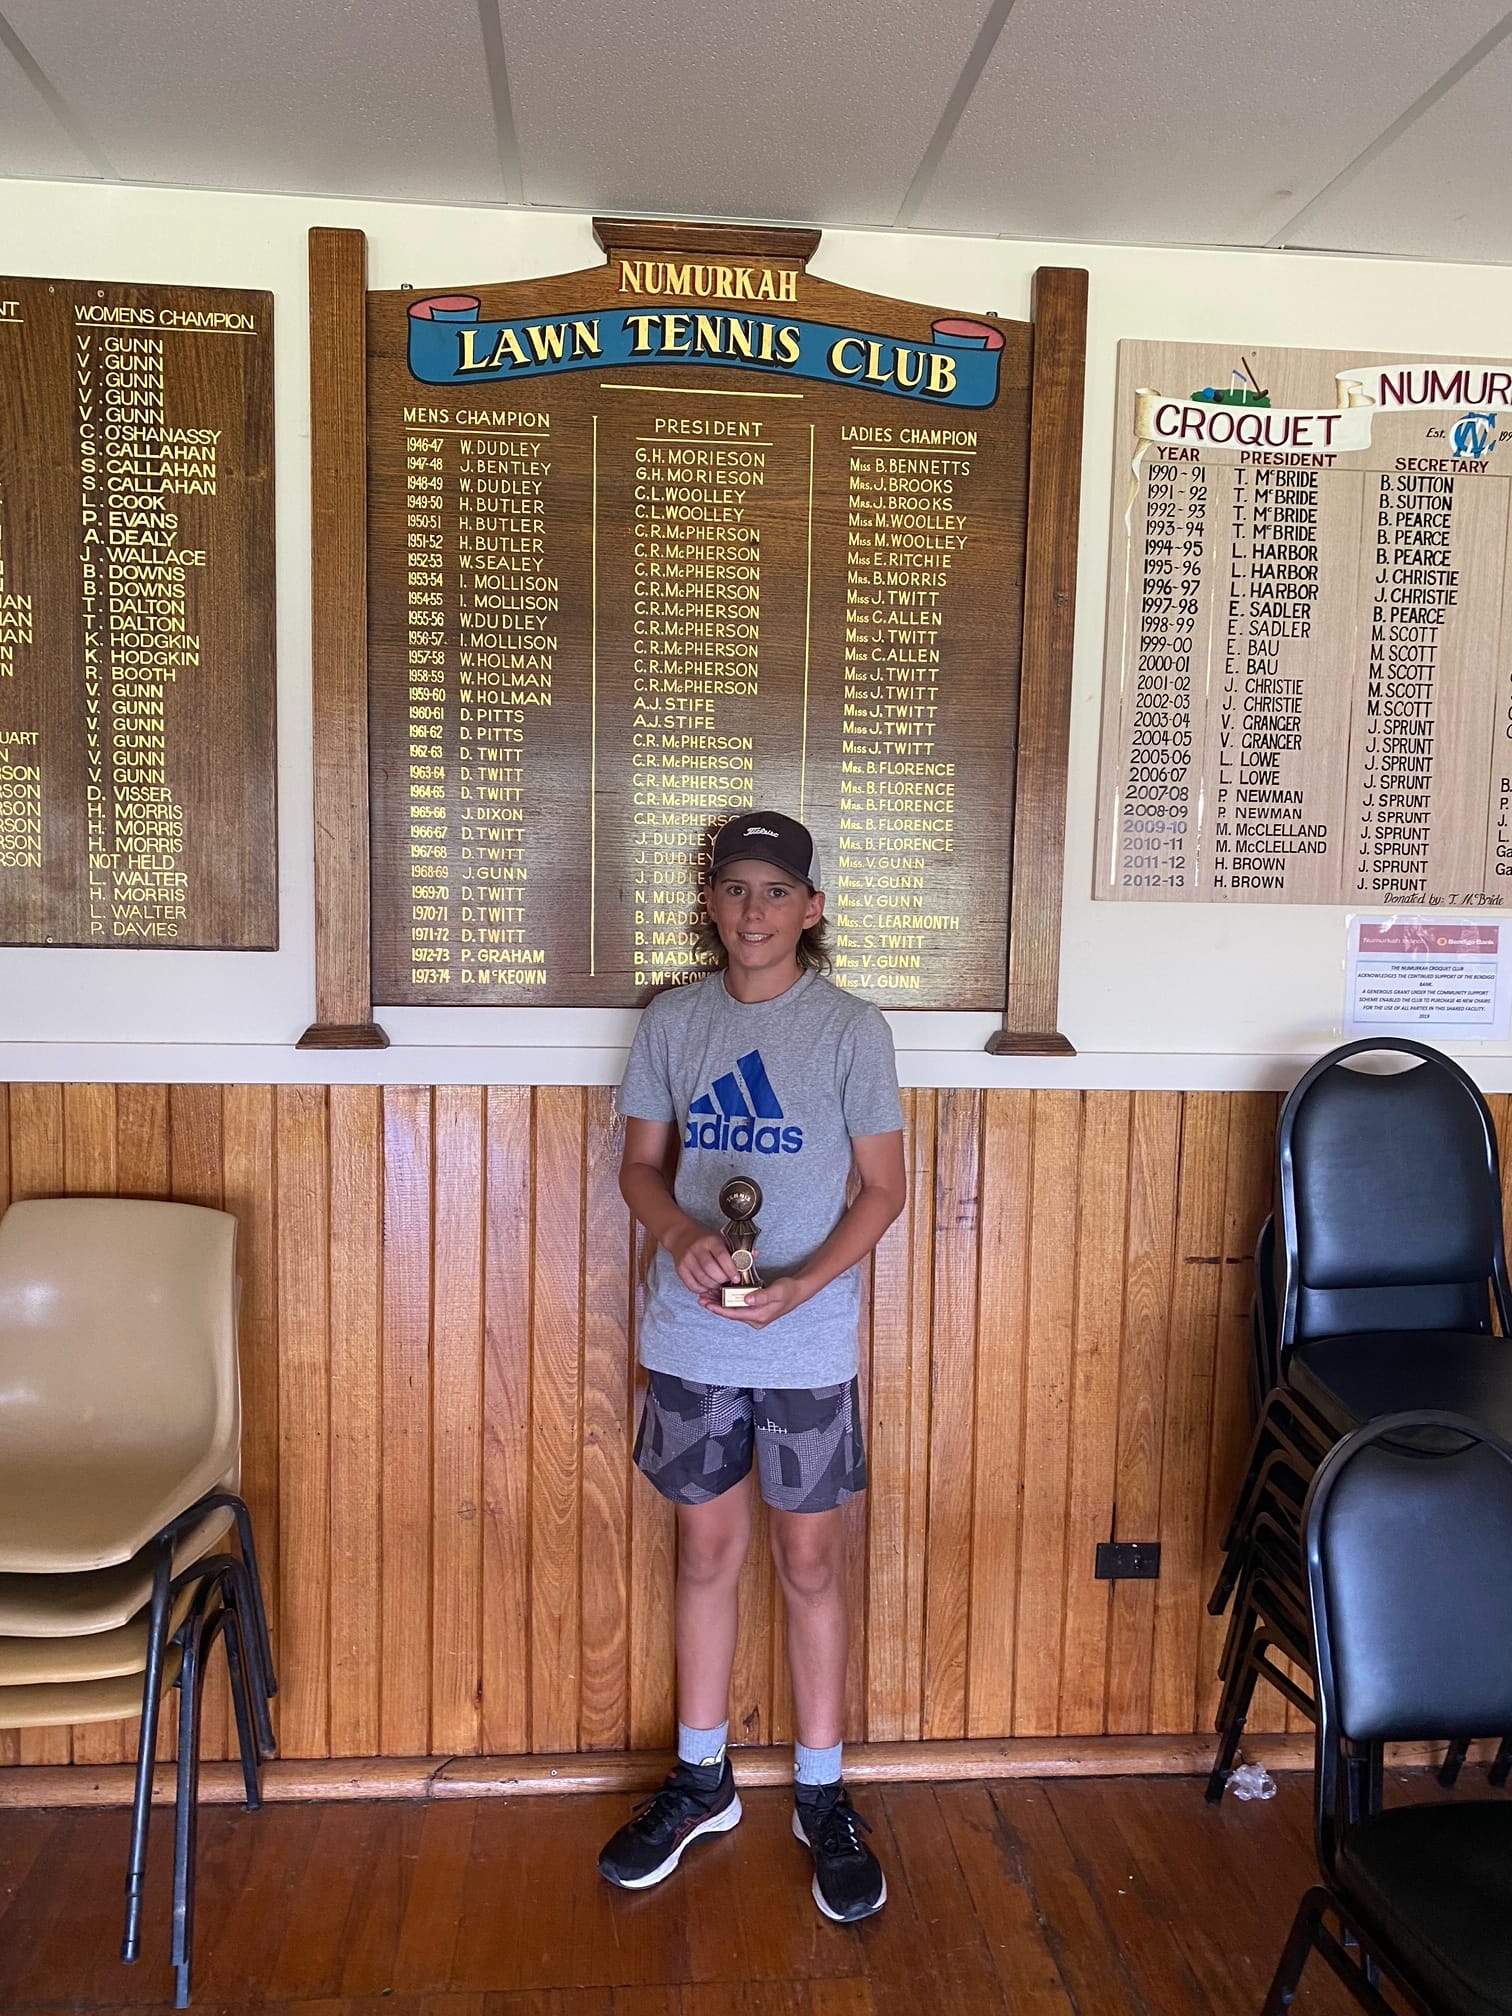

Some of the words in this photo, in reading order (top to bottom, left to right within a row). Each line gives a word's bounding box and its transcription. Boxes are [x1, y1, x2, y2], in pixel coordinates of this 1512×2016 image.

[619, 260, 798, 302] NUMURKAH
[75, 305, 154, 323] WOMENS
[160, 310, 253, 329] CHAMPION
[460, 320, 602, 369] LAWN
[627, 314, 799, 362] TENNIS
[832, 335, 956, 392] CLUB
[1381, 370, 1512, 405] NUMUR
[404, 408, 449, 423] MENS
[456, 410, 549, 427] CHAMPION
[1156, 404, 1341, 446] CROQUET
[656, 419, 763, 437] PRESIDENT
[842, 426, 892, 442] LADIES
[900, 429, 977, 446] CHAMPION
[407, 437, 444, 452] 1946-47
[1157, 446, 1199, 461] YEAR
[1241, 451, 1337, 467] PRESIDENT
[1395, 458, 1488, 473] SECRETARY
[1234, 468, 1248, 484] T.
[1381, 475, 1394, 491] B.
[1397, 475, 1454, 493] SUTTON
[83, 510, 102, 526] P.
[109, 511, 178, 529] EVANS
[408, 553, 442, 568] 1952-53
[1232, 543, 1246, 558] L.
[1253, 544, 1318, 561] HARBOR
[1377, 548, 1389, 564] B.
[1394, 549, 1451, 566] PEARCE
[409, 572, 443, 586] 1953-54
[475, 574, 558, 591] MOLLISON
[1375, 587, 1387, 602] J.
[1391, 588, 1458, 605] CHRISTIE
[1229, 600, 1244, 616] E.
[1250, 601, 1311, 619] SADLER
[409, 611, 444, 626] 1955-56
[85, 632, 103, 646] K.
[111, 633, 199, 649] HODGKIN
[86, 666, 102, 679] R.
[112, 667, 175, 681] BOOTH
[1139, 655, 1189, 672] 2000-01
[1225, 658, 1239, 674] E.
[1247, 659, 1278, 675] BAU
[86, 683, 100, 696] V.
[112, 684, 163, 698] GUNN
[1138, 675, 1190, 691] 2001-02
[1224, 678, 1237, 692] J.
[1245, 678, 1303, 695] CHRISTIE
[1368, 682, 1383, 697] M.
[1385, 683, 1433, 699] SCOTT
[410, 706, 444, 720] 1960-61
[1134, 711, 1190, 728] 2003-04
[1222, 714, 1234, 729] V.
[1243, 715, 1300, 731] GRANGER
[1131, 749, 1191, 765] 2005-06
[1220, 751, 1232, 766] L.
[1241, 751, 1280, 767] LOWE
[410, 765, 445, 779] 1963-64
[88, 786, 106, 800] D.
[114, 786, 171, 802] VISSER
[1125, 785, 1188, 801] 2007-08
[1218, 789, 1227, 802] P.
[1237, 789, 1303, 803] NEWMAN
[88, 803, 105, 818] H.
[115, 803, 182, 819] MORRIS
[1123, 819, 1187, 834] 2009-10
[1216, 823, 1231, 835] M.
[1236, 823, 1326, 837] McCLELLAND
[89, 854, 121, 869] NOT
[129, 854, 174, 870] HELD
[90, 871, 106, 885] L.
[112, 871, 188, 887] WALTER
[1123, 874, 1184, 887] 2012-13
[1214, 876, 1226, 887] H.
[1232, 876, 1284, 888] BROWN
[1357, 878, 1367, 889] J.
[1373, 878, 1427, 891] SPRUNT
[91, 922, 104, 935] P.
[114, 922, 177, 937] DAVIES
[412, 948, 450, 961] 1972-73
[478, 949, 544, 963] GRAHAM
[412, 969, 450, 983] 1973-74
[684, 1115, 803, 1153] adidas
